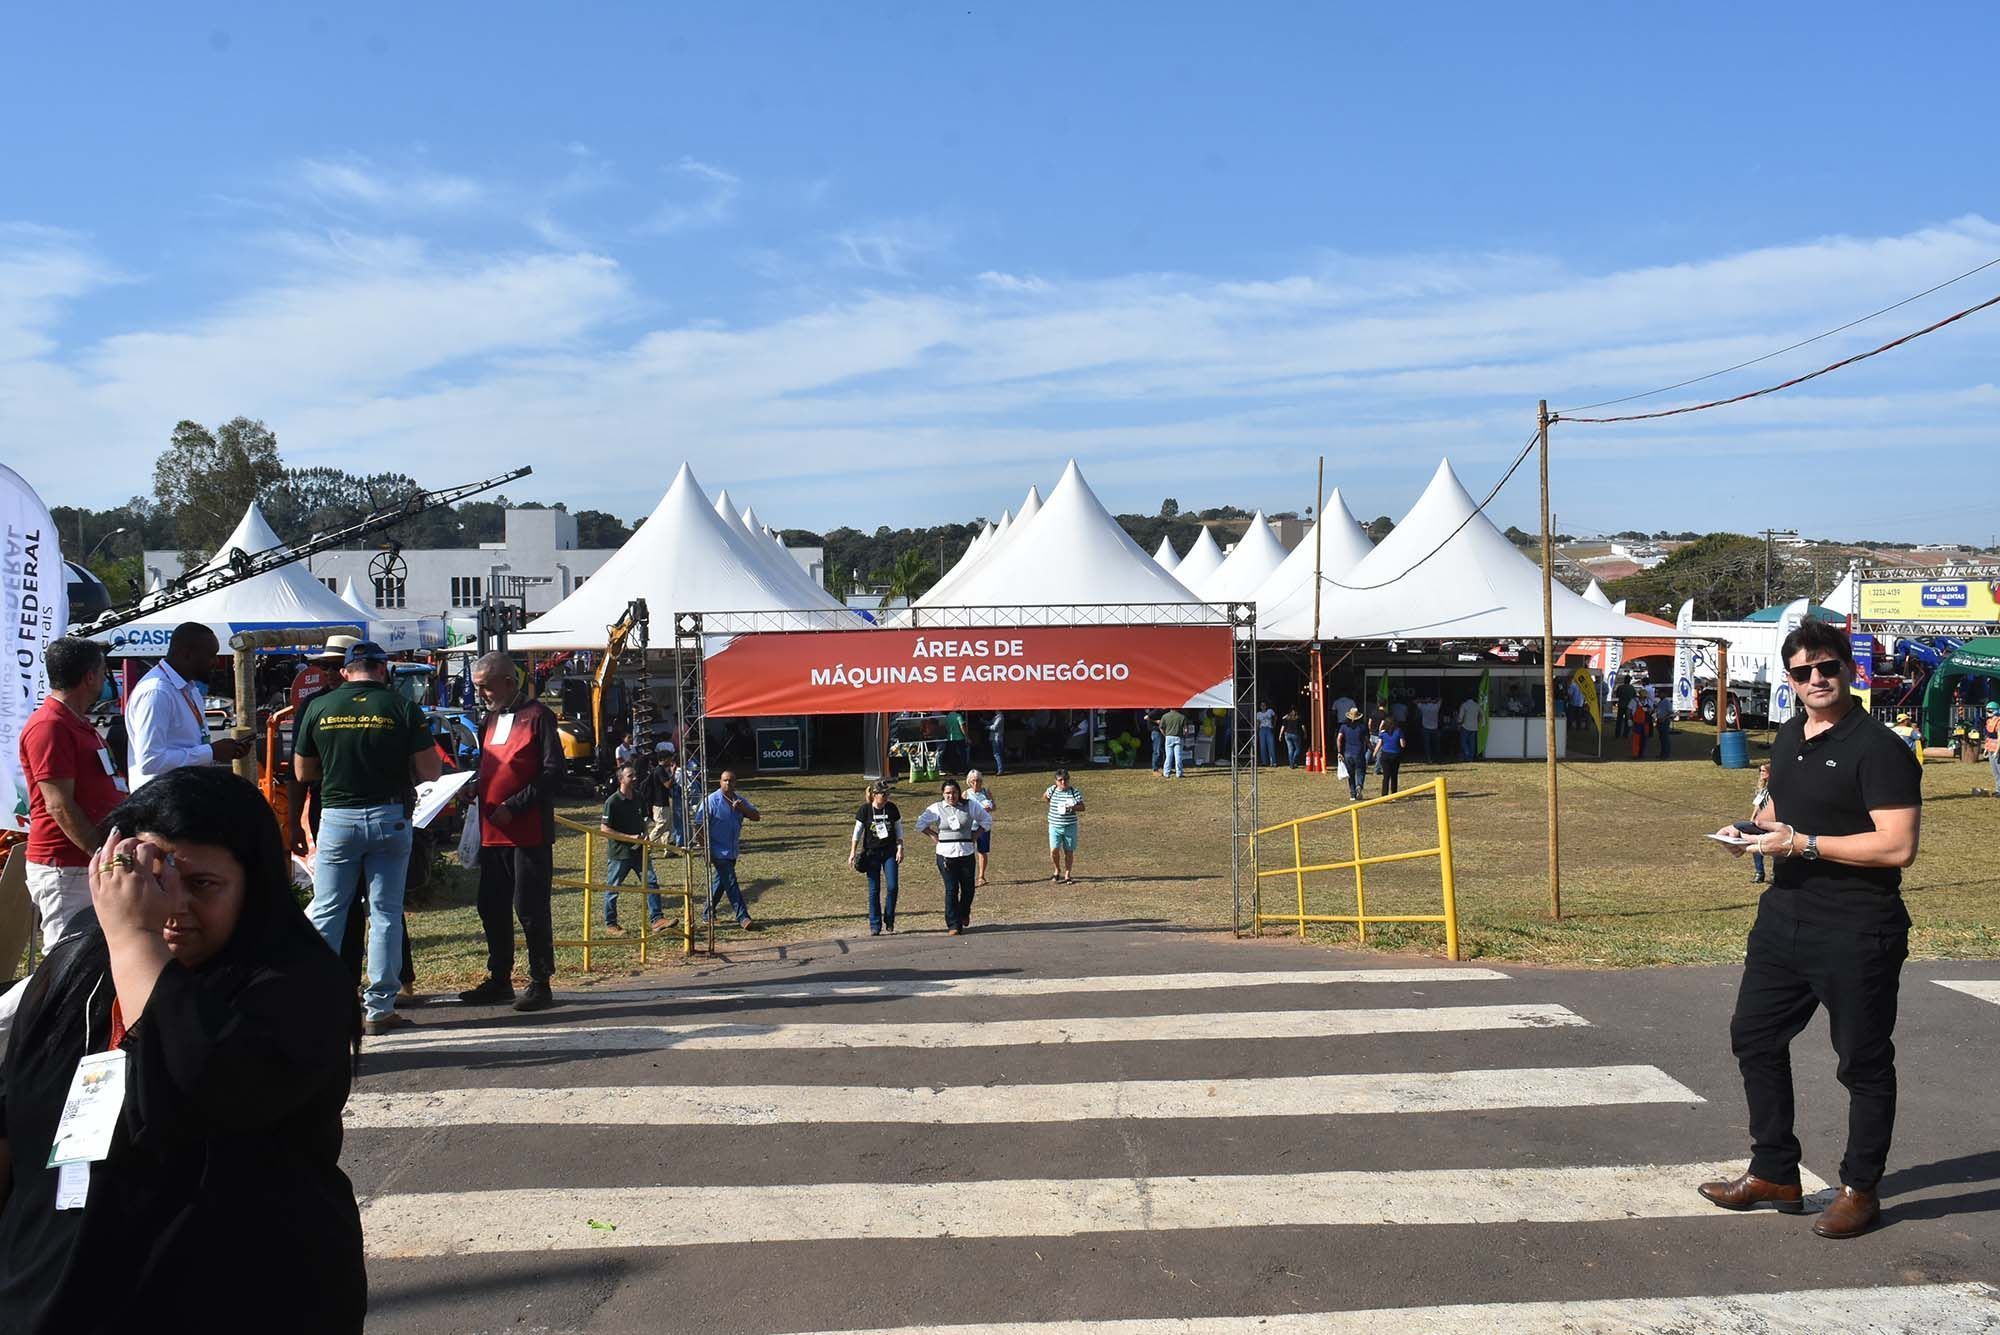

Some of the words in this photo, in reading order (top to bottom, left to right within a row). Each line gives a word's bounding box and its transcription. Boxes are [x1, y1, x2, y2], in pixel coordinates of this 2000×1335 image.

[18, 529, 40, 641] FEDERAL
[912, 637, 989, 658] ÁREAS
[994, 640, 1024, 657] DE
[811, 664, 938, 688] MÁQUINAS
[943, 666, 956, 682] E
[961, 660, 1129, 682] AGRONEGÓCIO
[319, 717, 326, 725] A
[327, 715, 356, 724] Estrela
[358, 714, 370, 722] do
[762, 750, 795, 758] SICOOB
